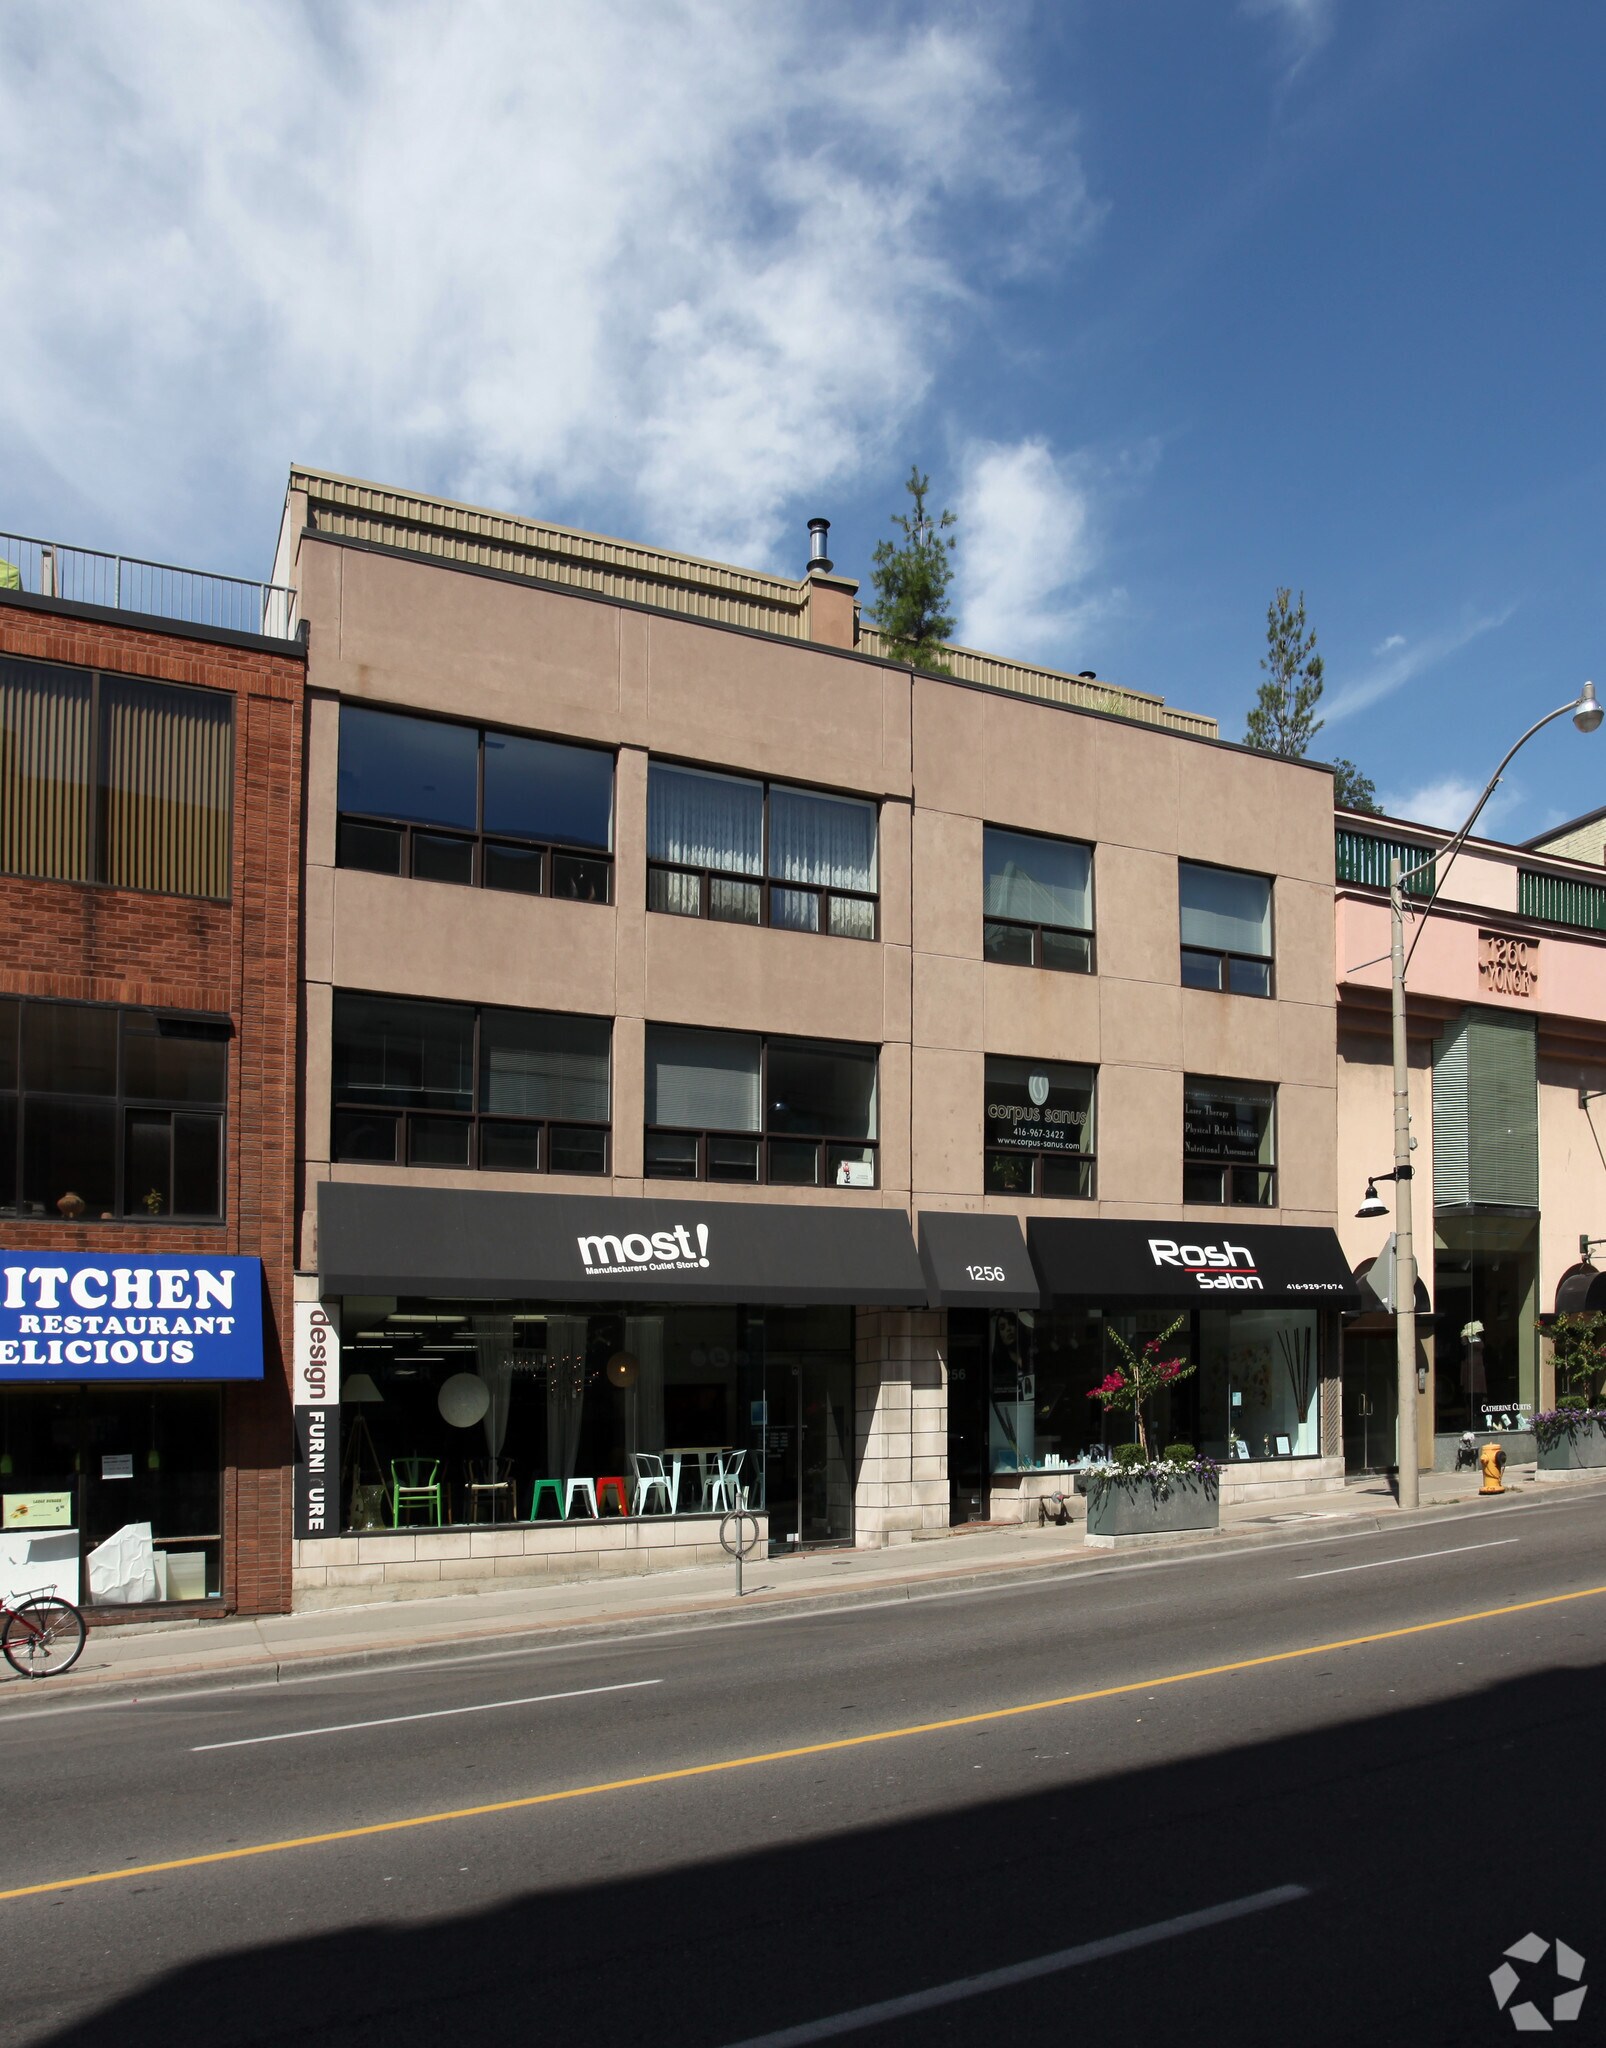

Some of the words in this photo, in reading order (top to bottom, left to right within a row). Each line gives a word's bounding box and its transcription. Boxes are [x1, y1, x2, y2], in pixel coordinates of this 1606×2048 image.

[1488, 937, 1528, 966] 1260
[988, 1104, 1040, 1125] corpus
[1044, 1108, 1087, 1125] sanus
[1204, 1105, 1229, 1118] Therapy
[997, 1137, 1080, 1149] www.corpus-sanus.com
[1013, 1128, 1064, 1139] 416-967-3422
[577, 1223, 710, 1268] most!
[1147, 1239, 1256, 1267] Rosh
[585, 1264, 647, 1275] Manufacturers
[649, 1262, 675, 1270] Outlet
[677, 1261, 699, 1269] Store
[966, 1266, 1005, 1282] 1256
[0, 1267, 235, 1309] ITCHEN
[1196, 1272, 1263, 1289] Salon
[19, 1315, 235, 1334] RESTAURANT
[303, 1310, 332, 1399] design
[1481, 1404, 1511, 1413] CATHERINE
[1512, 1402, 1532, 1411] CURTIS
[308, 1412, 326, 1531] FURNIURE
